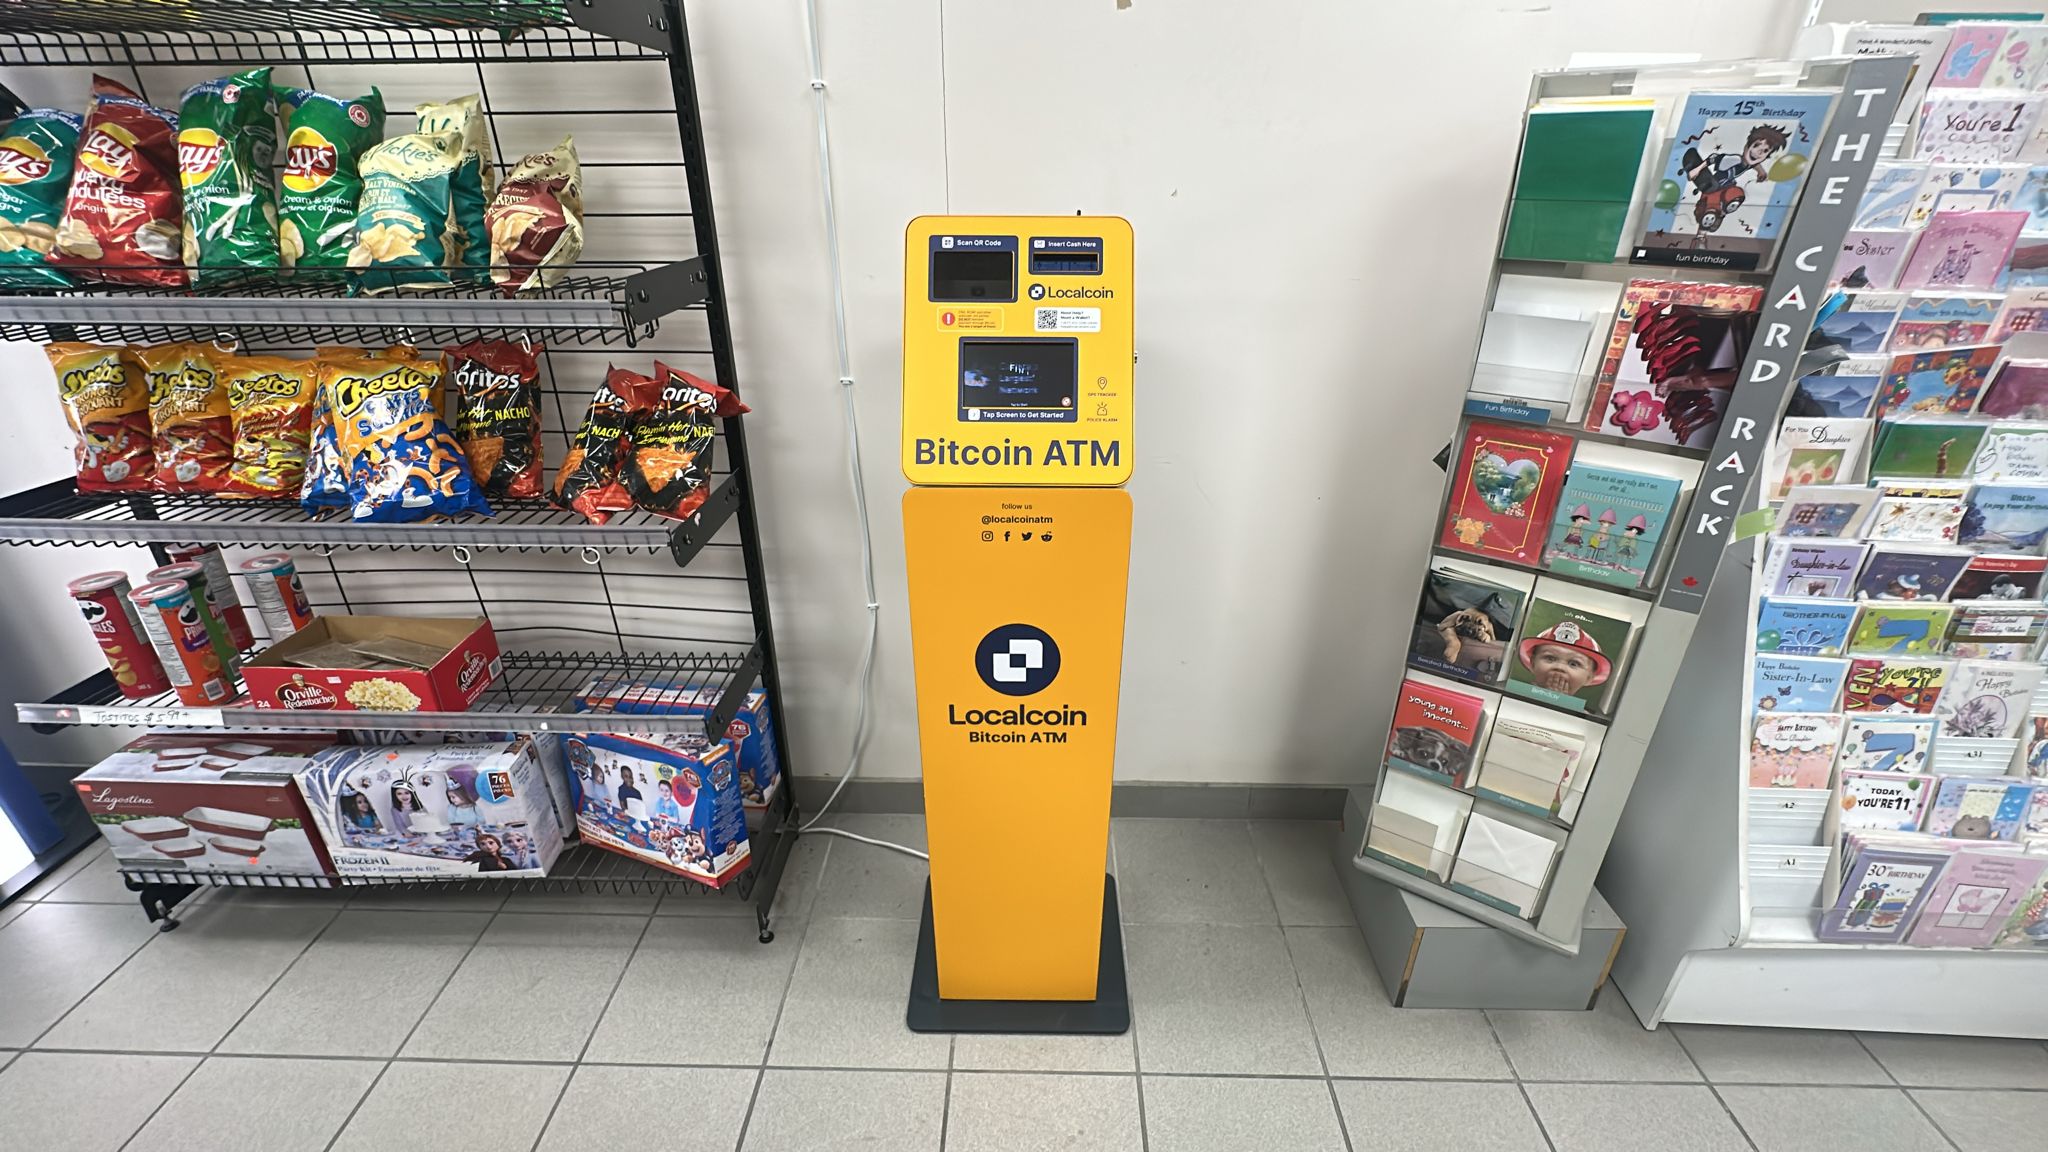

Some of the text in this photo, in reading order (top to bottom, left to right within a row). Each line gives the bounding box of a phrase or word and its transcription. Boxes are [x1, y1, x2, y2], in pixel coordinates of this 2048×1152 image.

[1698, 107, 1728, 117] Happy
[1762, 108, 1807, 118] Birthday
[1944, 102, 2026, 132] You're 1
[1819, 88, 1887, 205] THE
[974, 239, 984, 247] QR
[1675, 253, 1730, 265] fun birthday
[1048, 286, 1114, 299] Localcoin
[1750, 246, 1823, 383] CARD
[494, 407, 531, 420] NACHO
[983, 412, 995, 420] Tap
[1485, 403, 1530, 417] Fun Birthday
[915, 438, 1120, 467] Bitcoin ATM
[1696, 417, 1757, 536] RACK
[981, 515, 1053, 525] @localcoinatm
[1578, 564, 1610, 577] Birthday
[1762, 671, 1834, 684] Sister-In-Law
[284, 686, 323, 700] Orville
[257, 700, 271, 708] 24
[1408, 695, 1453, 715] young and
[949, 704, 1087, 726] Localcoin
[1423, 709, 1469, 730] innocent...
[969, 731, 1067, 743] Bitcoin ATM
[491, 775, 506, 784] 76
[1871, 788, 1901, 796] TODAY
[92, 787, 154, 811] Lagostina
[1857, 797, 1911, 811] YOU'RE 11
[333, 856, 381, 865] FROZEN
